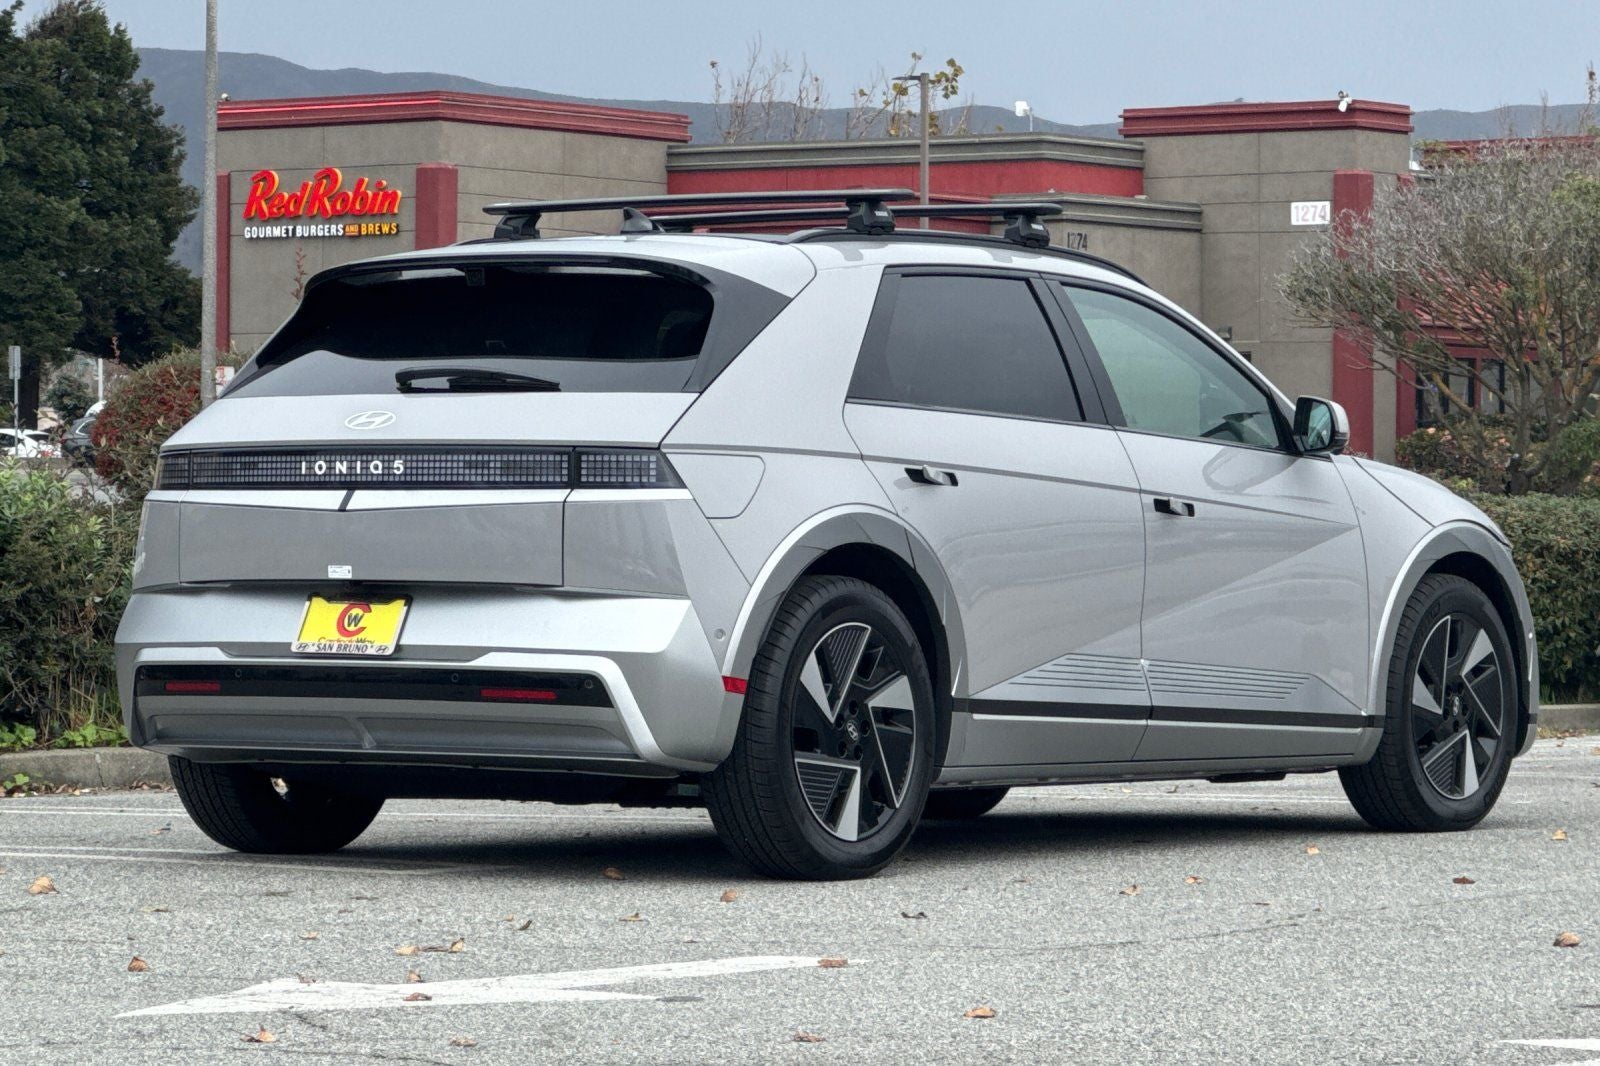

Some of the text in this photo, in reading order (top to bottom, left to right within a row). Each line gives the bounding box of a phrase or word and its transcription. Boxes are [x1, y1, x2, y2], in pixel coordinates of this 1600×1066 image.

[243, 168, 402, 220] Red Robin
[1294, 203, 1328, 222] 1274
[244, 223, 397, 239] GOURMET BURGERS AND BREWS
[300, 460, 405, 474] IONIQ 5
